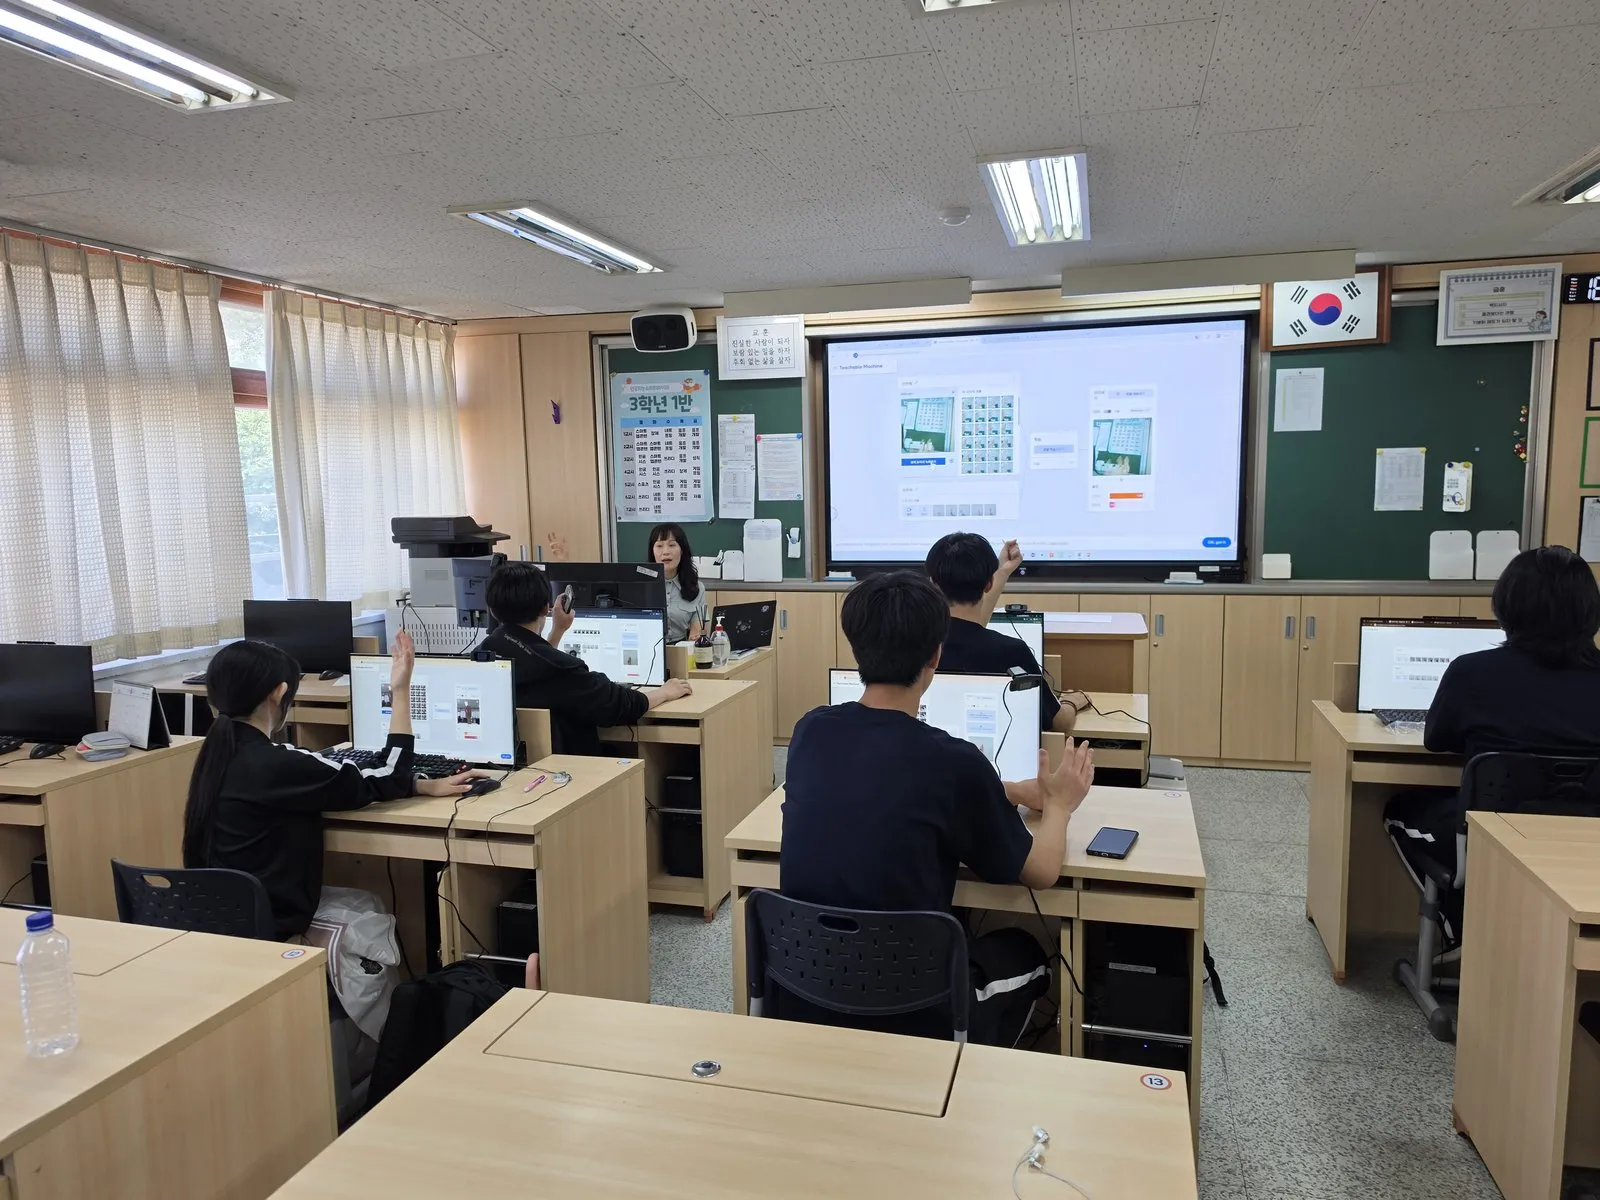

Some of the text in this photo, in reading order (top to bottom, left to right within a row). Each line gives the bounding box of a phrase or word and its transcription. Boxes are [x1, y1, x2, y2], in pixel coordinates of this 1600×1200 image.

[732, 339, 751, 348] 진실한
[755, 338, 774, 346] 사람이
[733, 349, 745, 357] 보람
[748, 348, 760, 356] 있는
[762, 348, 774, 356] 일을
[748, 358, 760, 366] 없는
[629, 395, 693, 413] 3학년 1반
[1148, 1077, 1164, 1086] 13
